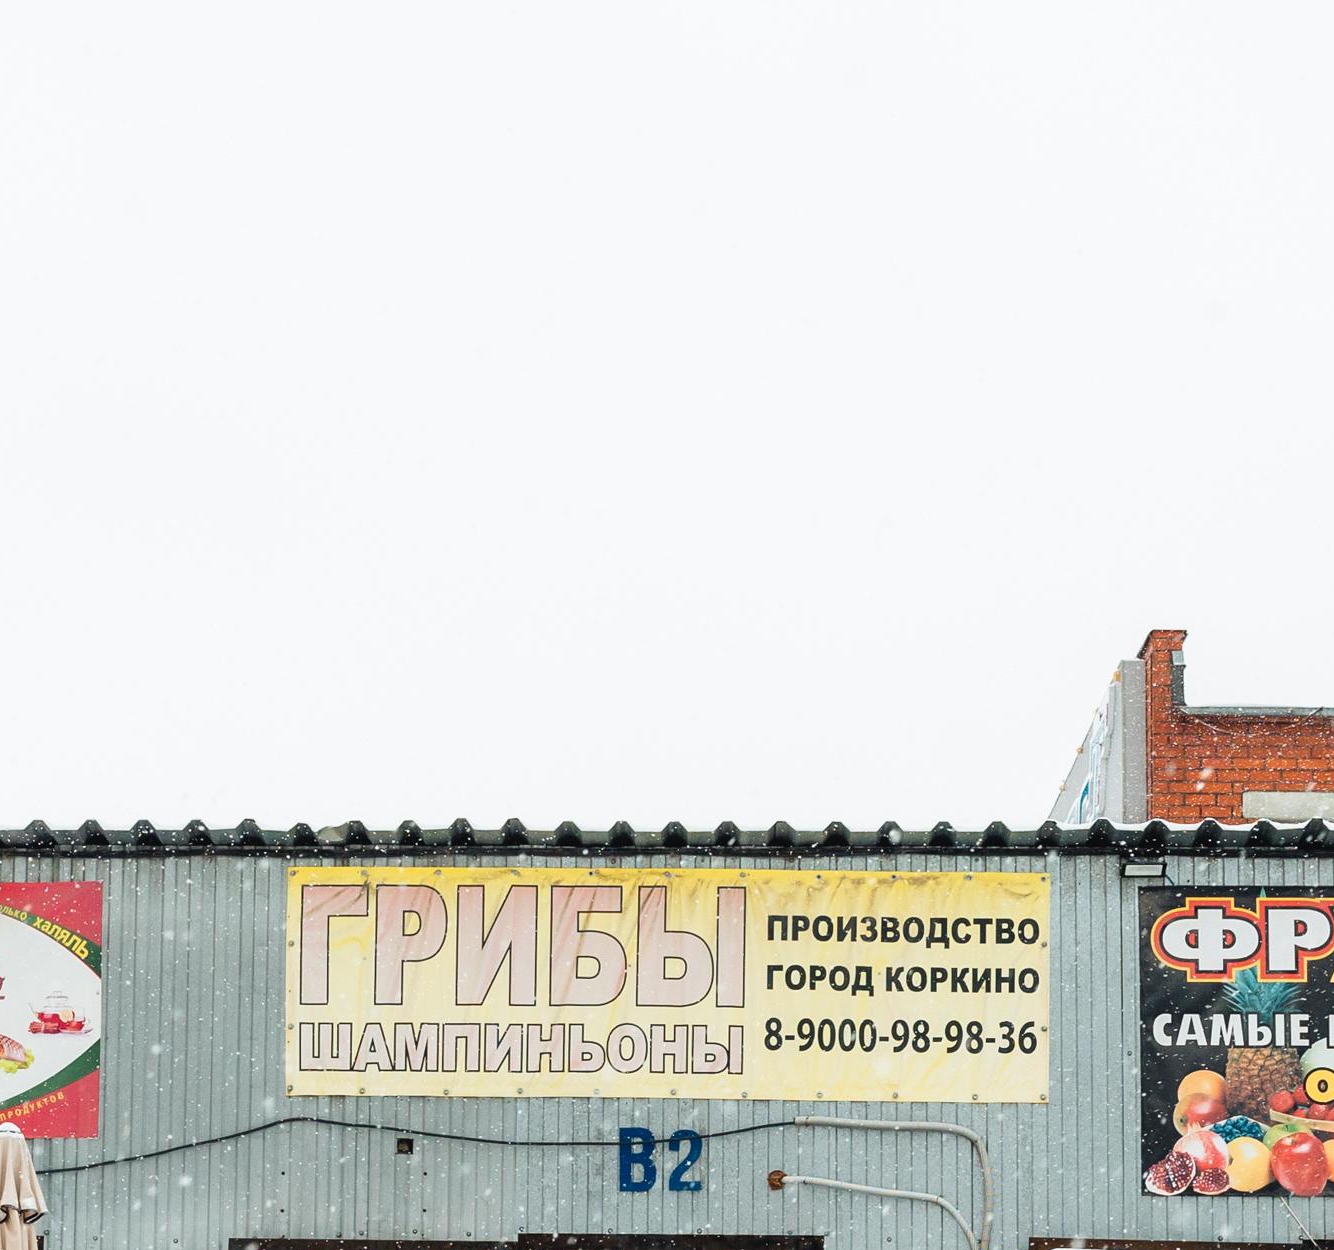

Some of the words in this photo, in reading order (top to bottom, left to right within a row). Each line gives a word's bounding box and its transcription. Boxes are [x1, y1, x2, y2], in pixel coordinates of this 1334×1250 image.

[32, 916, 90, 960] халяль
[299, 884, 747, 1008] ГРИБЫ
[767, 914, 1041, 951] ПРОИЗВОДСТВО
[766, 964, 875, 997] ГОРОД
[885, 965, 1041, 994] КОРКИНО
[298, 1022, 744, 1075] ШАМПИНЬОНЫ
[764, 1017, 1038, 1055] 8-9000-98-98-36
[1152, 1012, 1310, 1049] САМЫЕ
[0, 1092, 65, 1122] ПРОДУКТОВ
